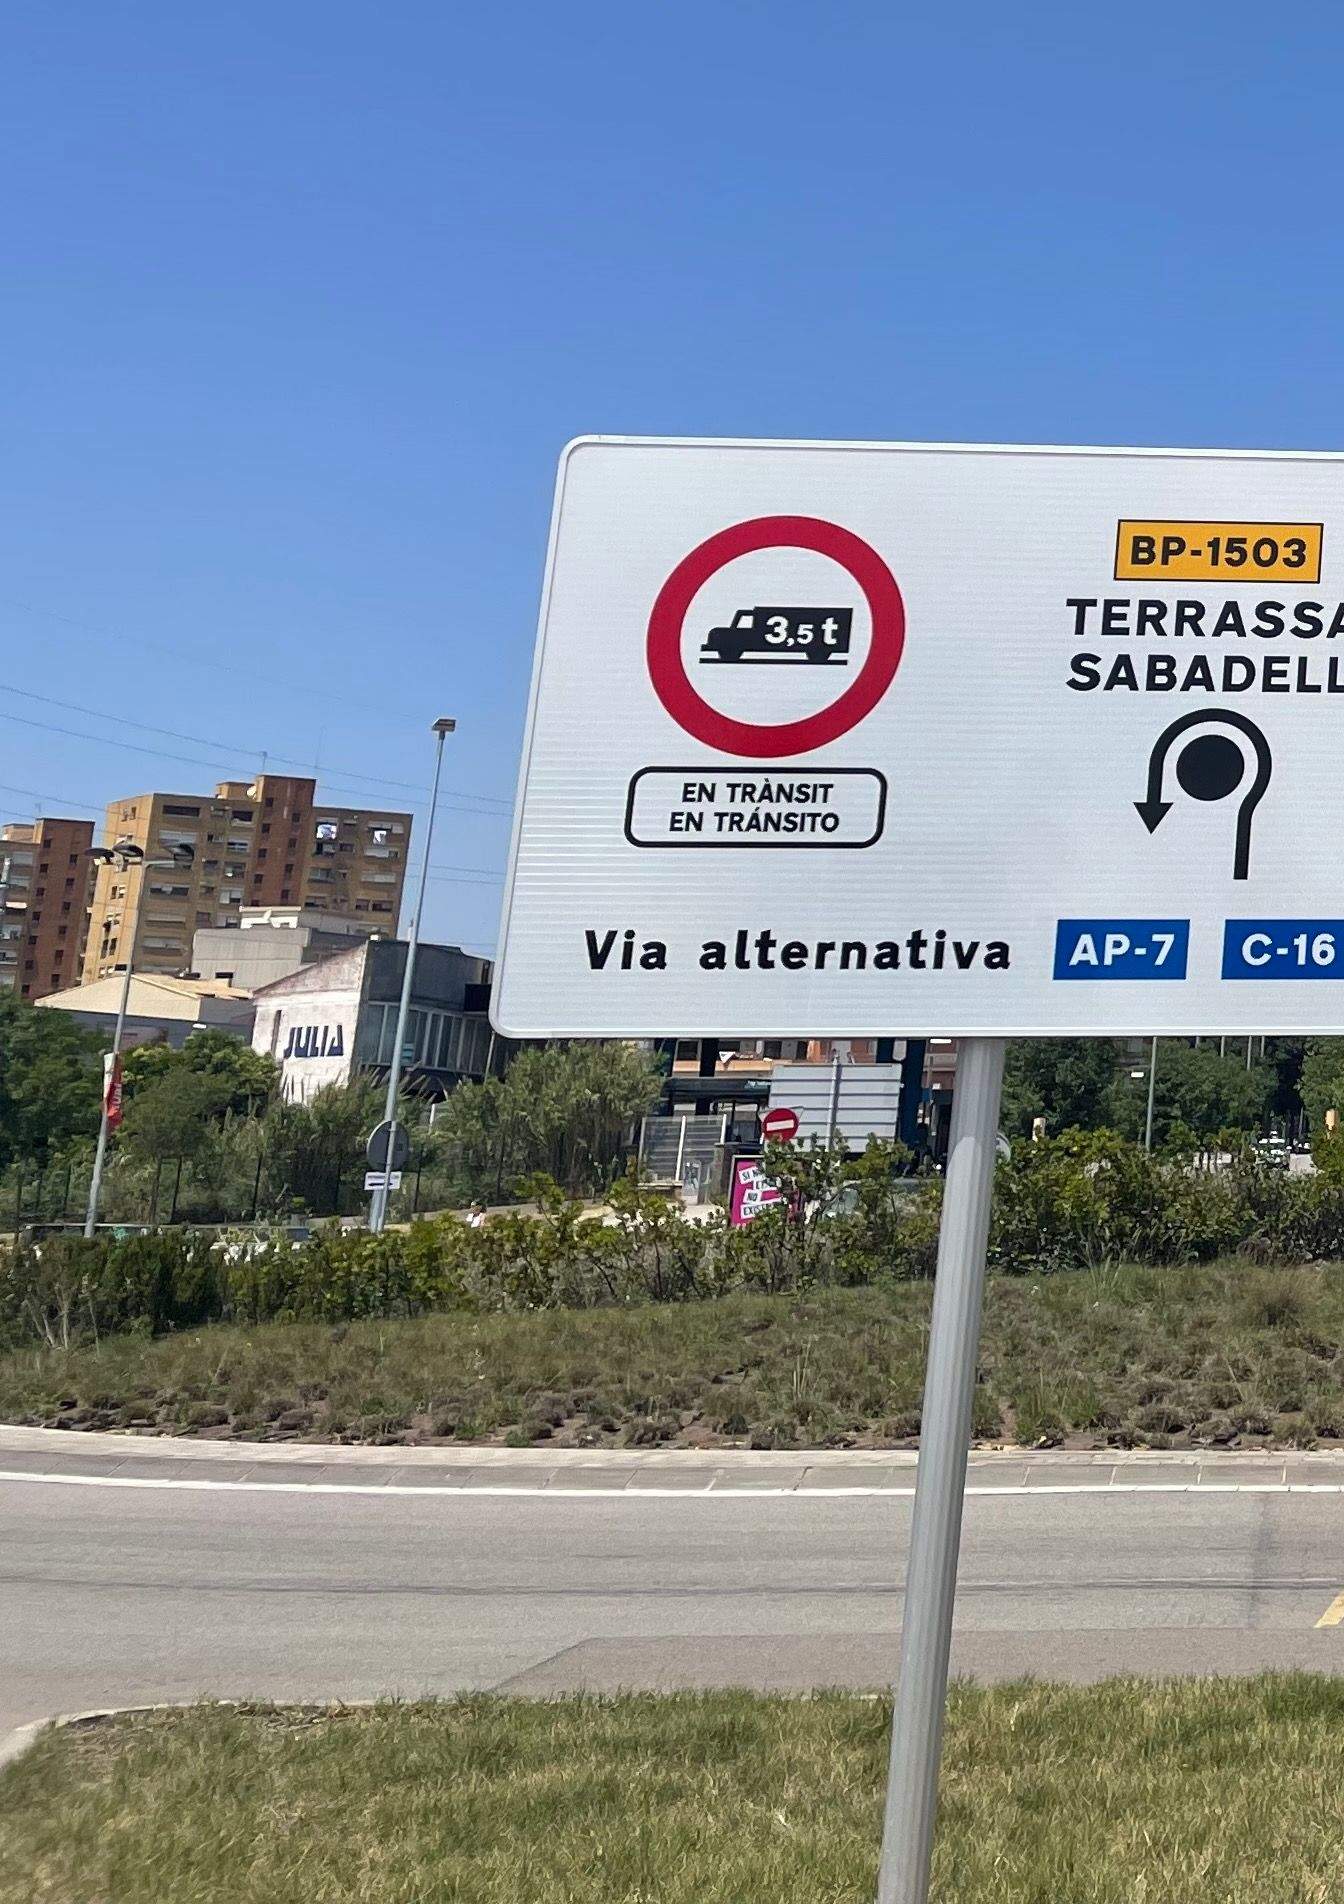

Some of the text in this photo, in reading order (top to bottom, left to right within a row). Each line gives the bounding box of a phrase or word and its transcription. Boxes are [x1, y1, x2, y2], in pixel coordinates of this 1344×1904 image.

[1131, 535, 1307, 568] BP-1503
[764, 615, 839, 646] 3,5 t
[682, 778, 834, 803] EN TRÀNSIT
[669, 807, 840, 832] EN TRÁNSITO
[585, 929, 1011, 970] Via alternativa
[1068, 933, 1175, 966] AP-7
[1241, 933, 1336, 966] C-16
